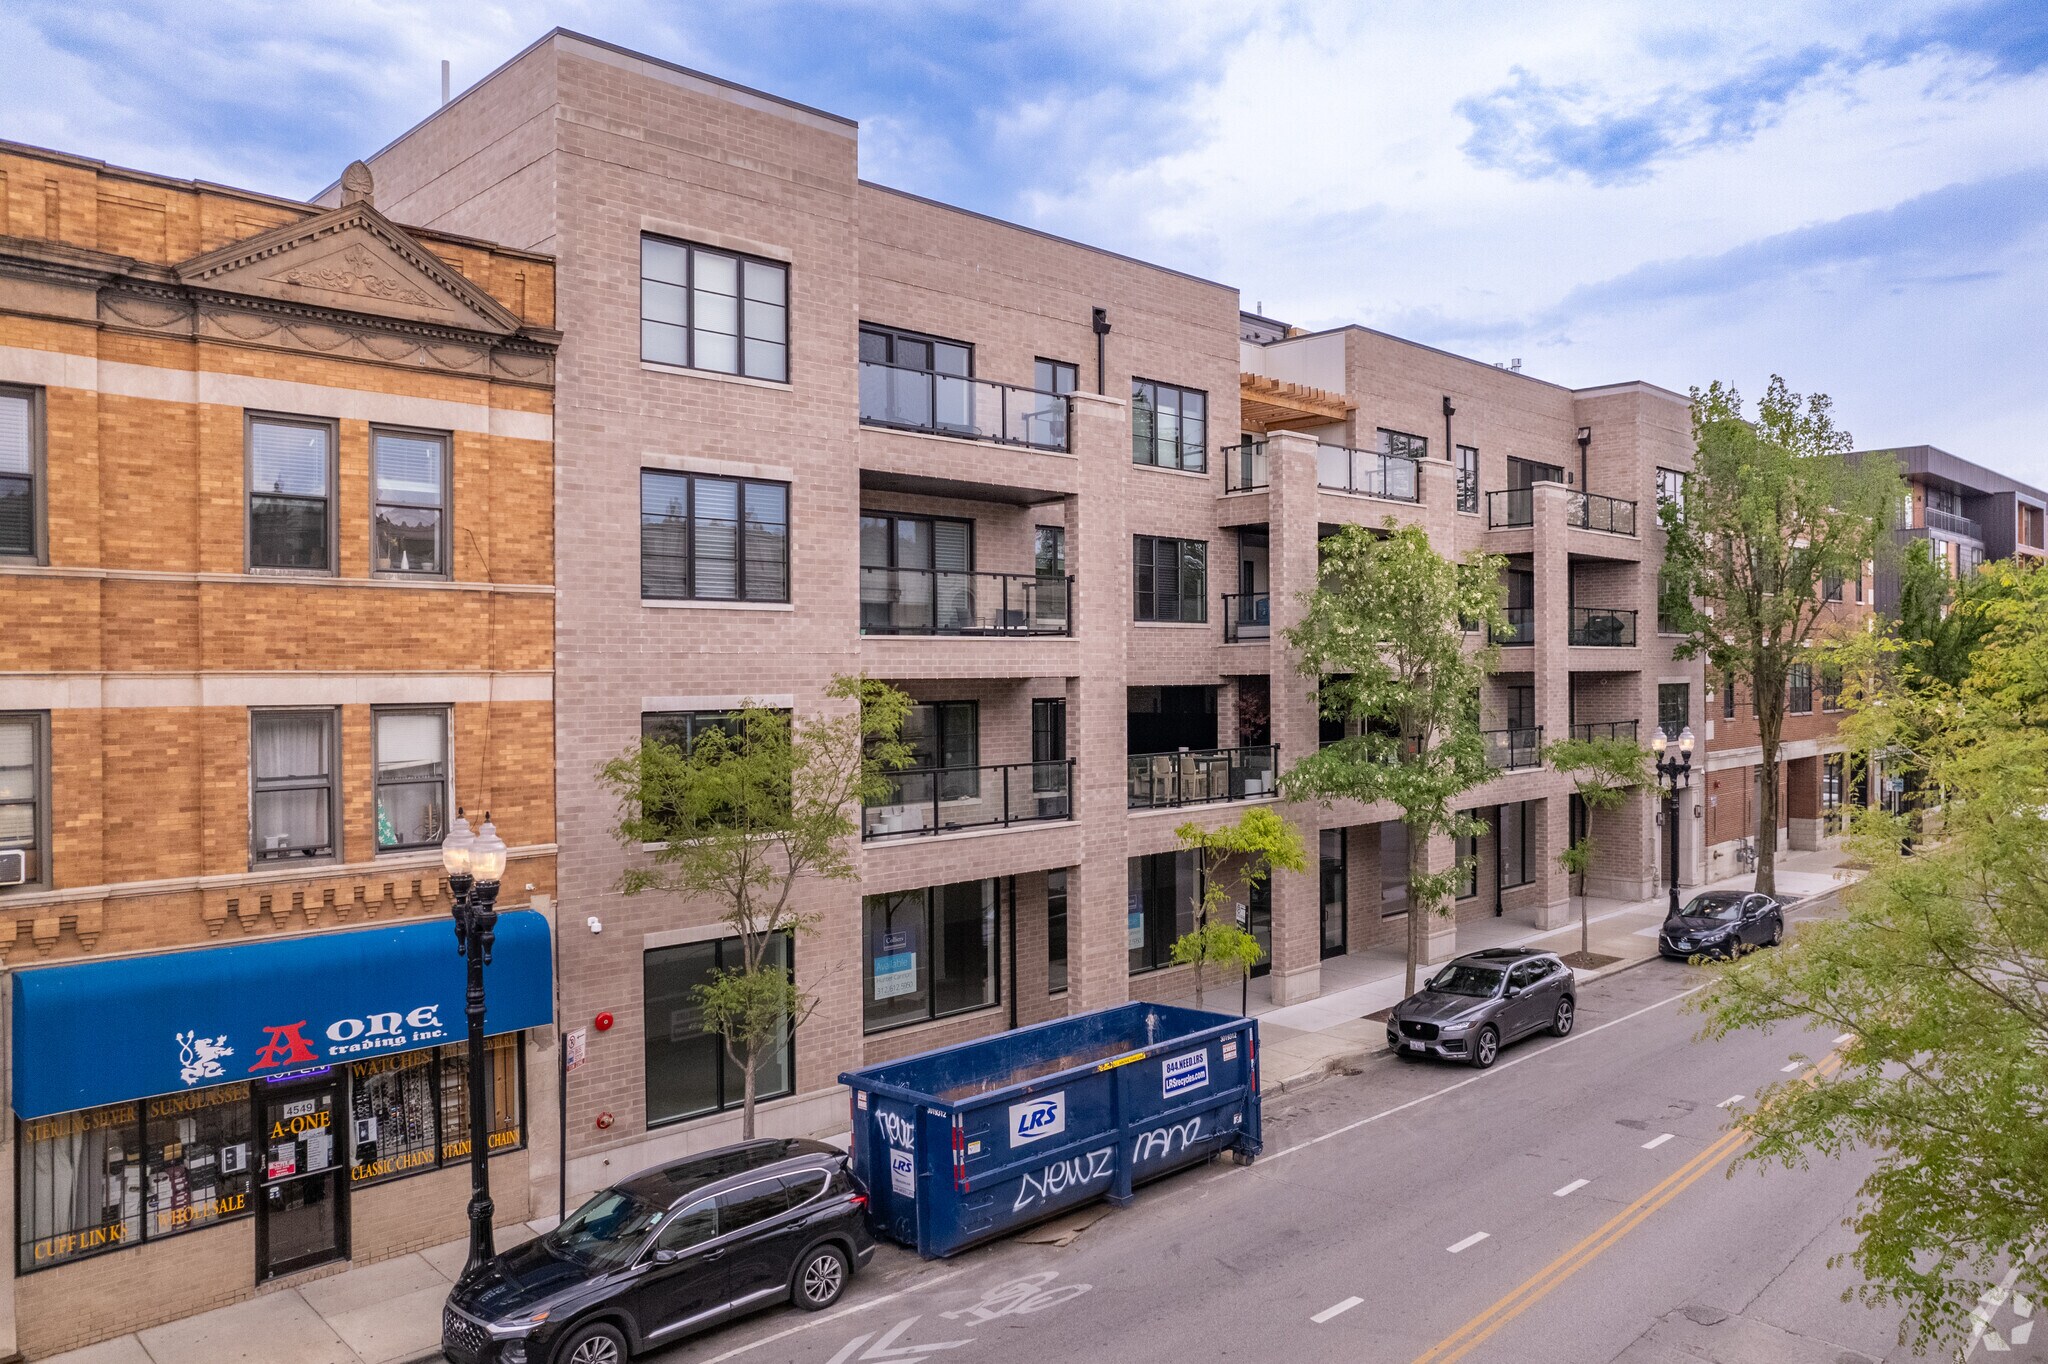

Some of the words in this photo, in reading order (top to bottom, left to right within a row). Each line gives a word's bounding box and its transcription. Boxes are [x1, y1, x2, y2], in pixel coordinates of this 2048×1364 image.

[876, 958, 908, 971] Available
[249, 1020, 319, 1072] A
[329, 1035, 406, 1056] trading
[413, 1029, 448, 1042] inc.
[353, 1051, 431, 1078] WATCHES
[151, 1086, 250, 1118] SUNGLASSES
[286, 1103, 313, 1116] 4549
[26, 1114, 91, 1143] STERLING
[93, 1106, 136, 1130] SILVER
[271, 1111, 331, 1139] A-ONE
[1017, 1105, 1058, 1134] LRS
[351, 1158, 396, 1181] CLASSIC
[396, 1150, 435, 1170] CHAINS
[892, 1158, 912, 1173] LRS
[157, 1194, 245, 1228] WHOLESALE
[35, 1233, 77, 1260] CUFF
